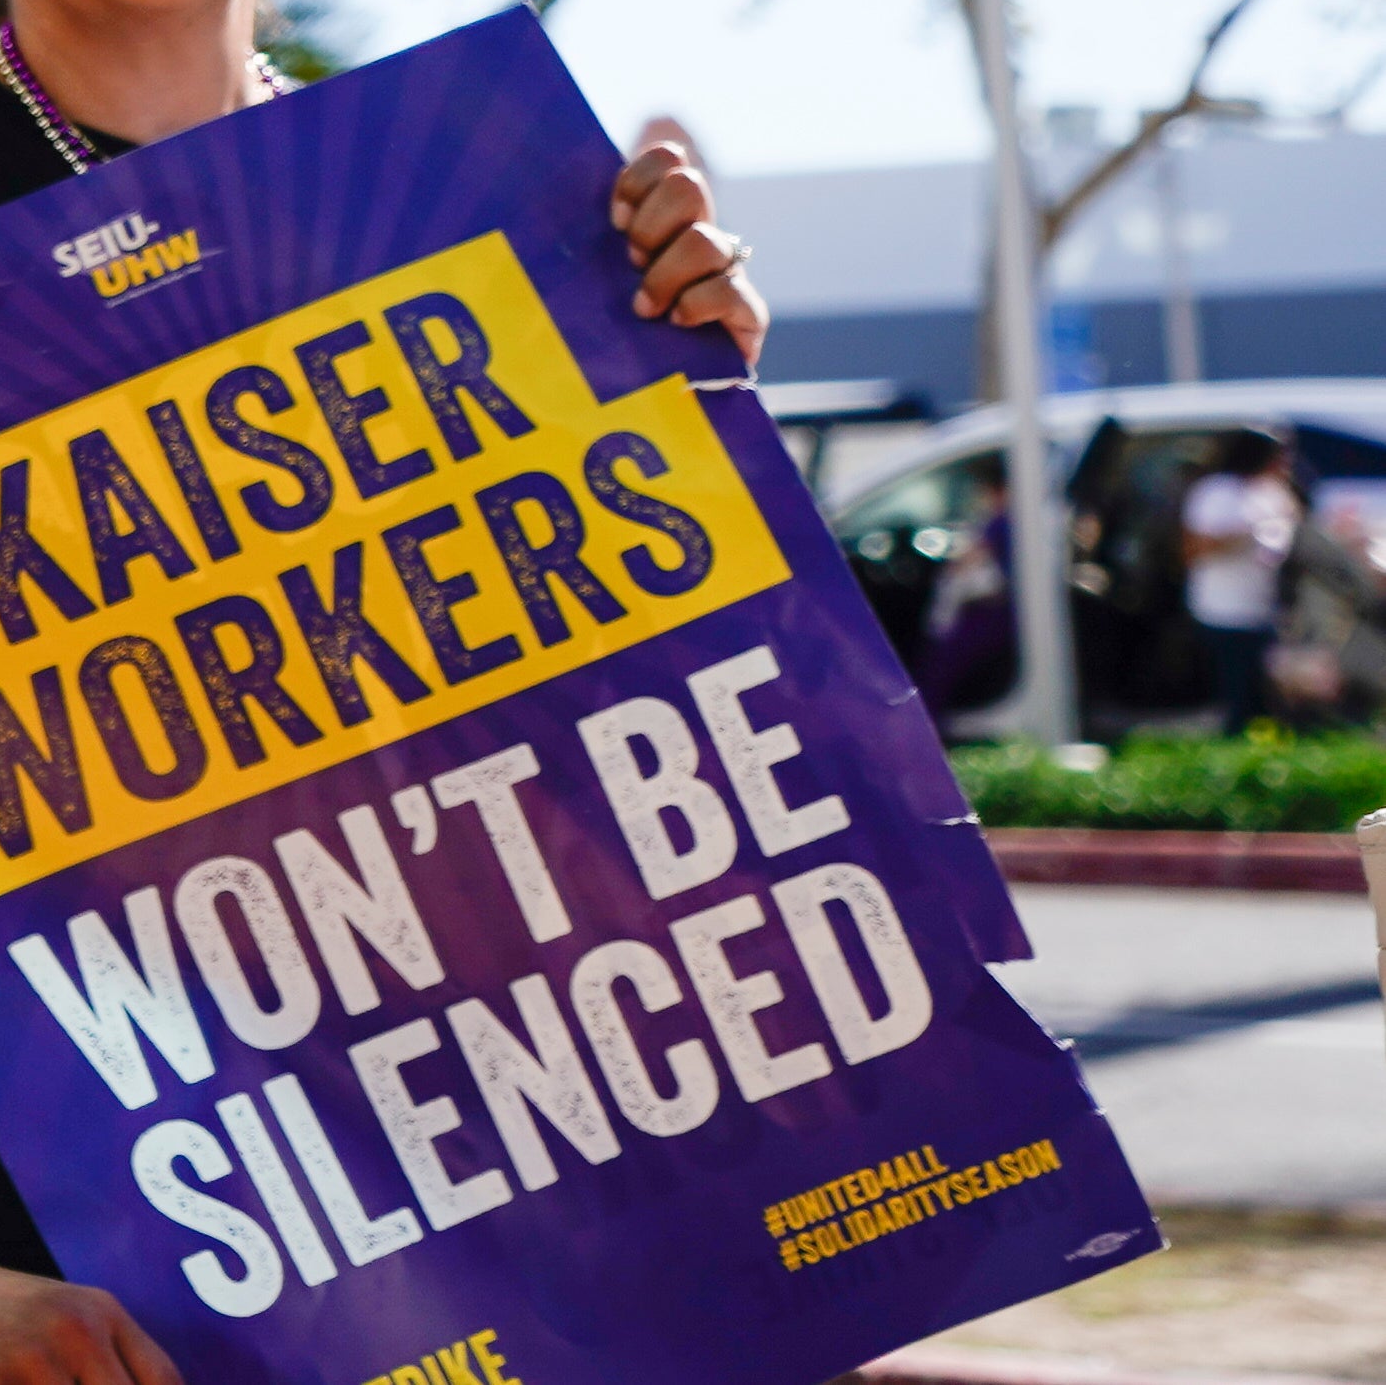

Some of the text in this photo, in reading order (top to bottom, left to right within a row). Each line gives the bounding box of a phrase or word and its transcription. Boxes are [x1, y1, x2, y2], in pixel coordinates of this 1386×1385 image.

[91, 229, 202, 298] UHW
[7, 645, 851, 1110] WON'T BE
[129, 862, 934, 1318] SILENCED
[764, 1145, 949, 1239] #UNITED4ALL
[778, 1138, 1062, 1273] #SOLIDARITYSEASON
